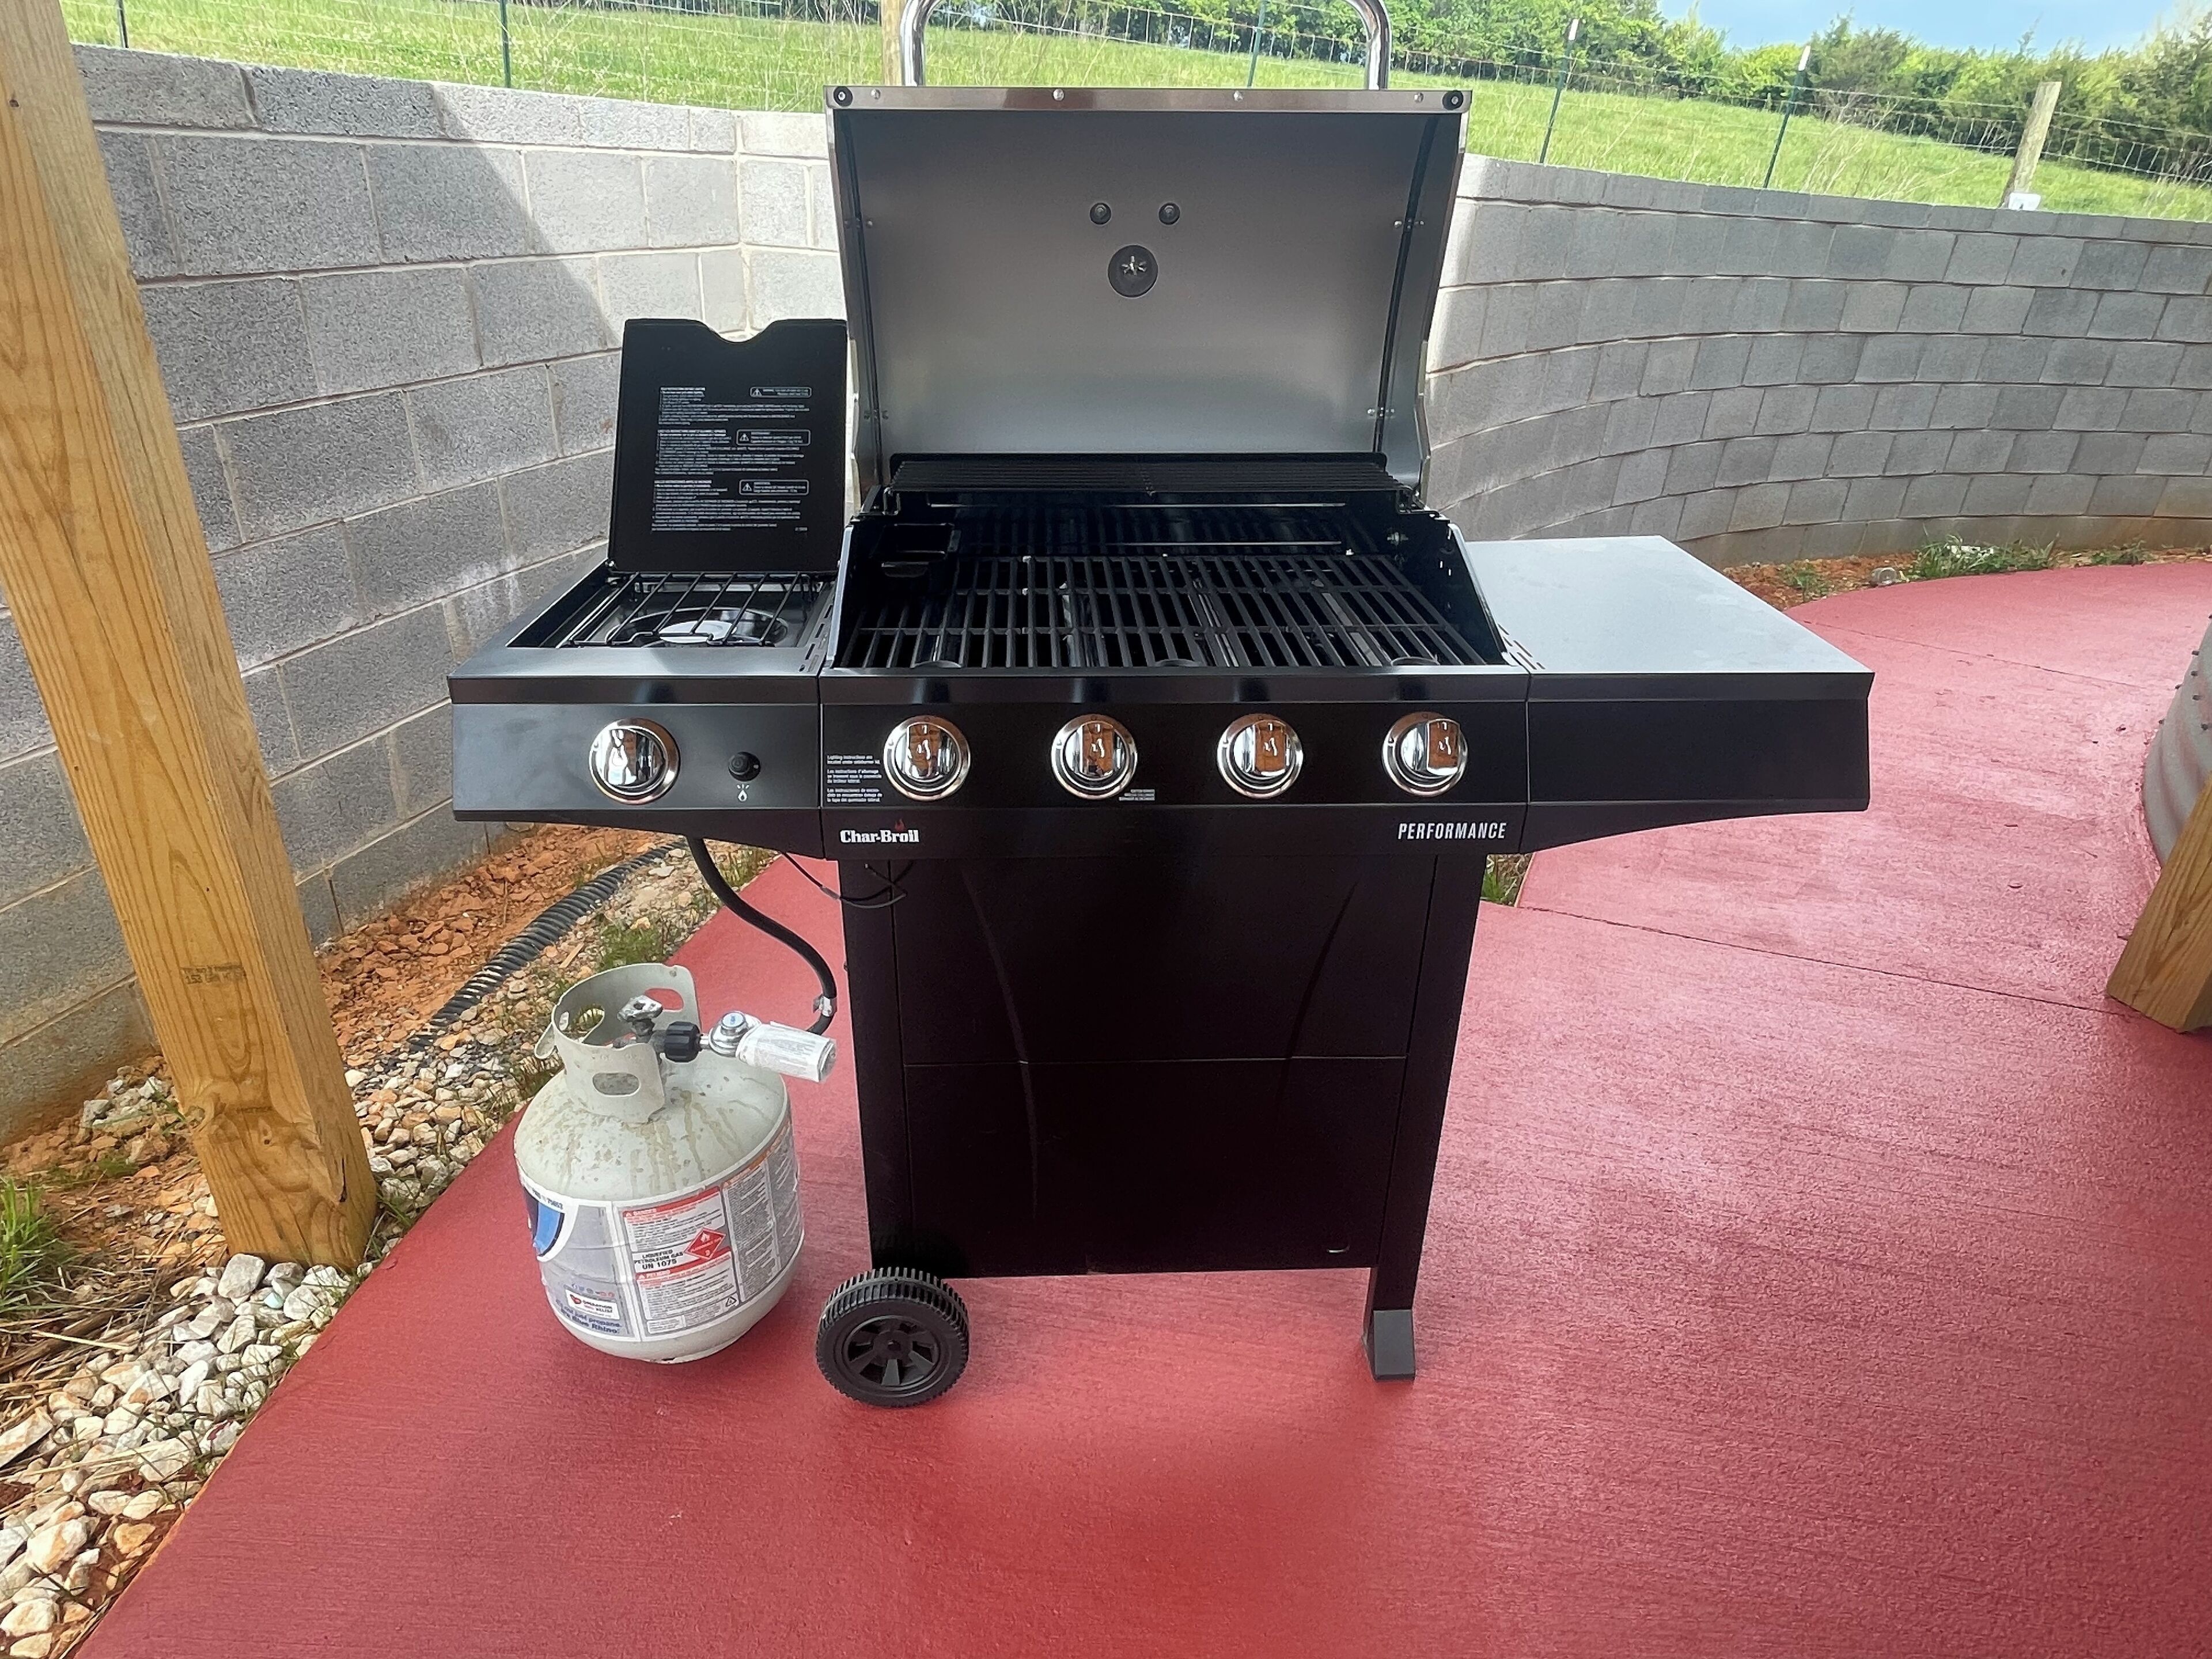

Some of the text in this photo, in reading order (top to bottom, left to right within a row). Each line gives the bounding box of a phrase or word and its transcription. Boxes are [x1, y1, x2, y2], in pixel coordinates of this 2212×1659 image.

[839, 829, 920, 843] Char-Broil
[1397, 822, 1507, 840] PERFORMANCE
[634, 1251, 684, 1264] PETROLEUM GAS
[657, 1258, 677, 1267] 1075
